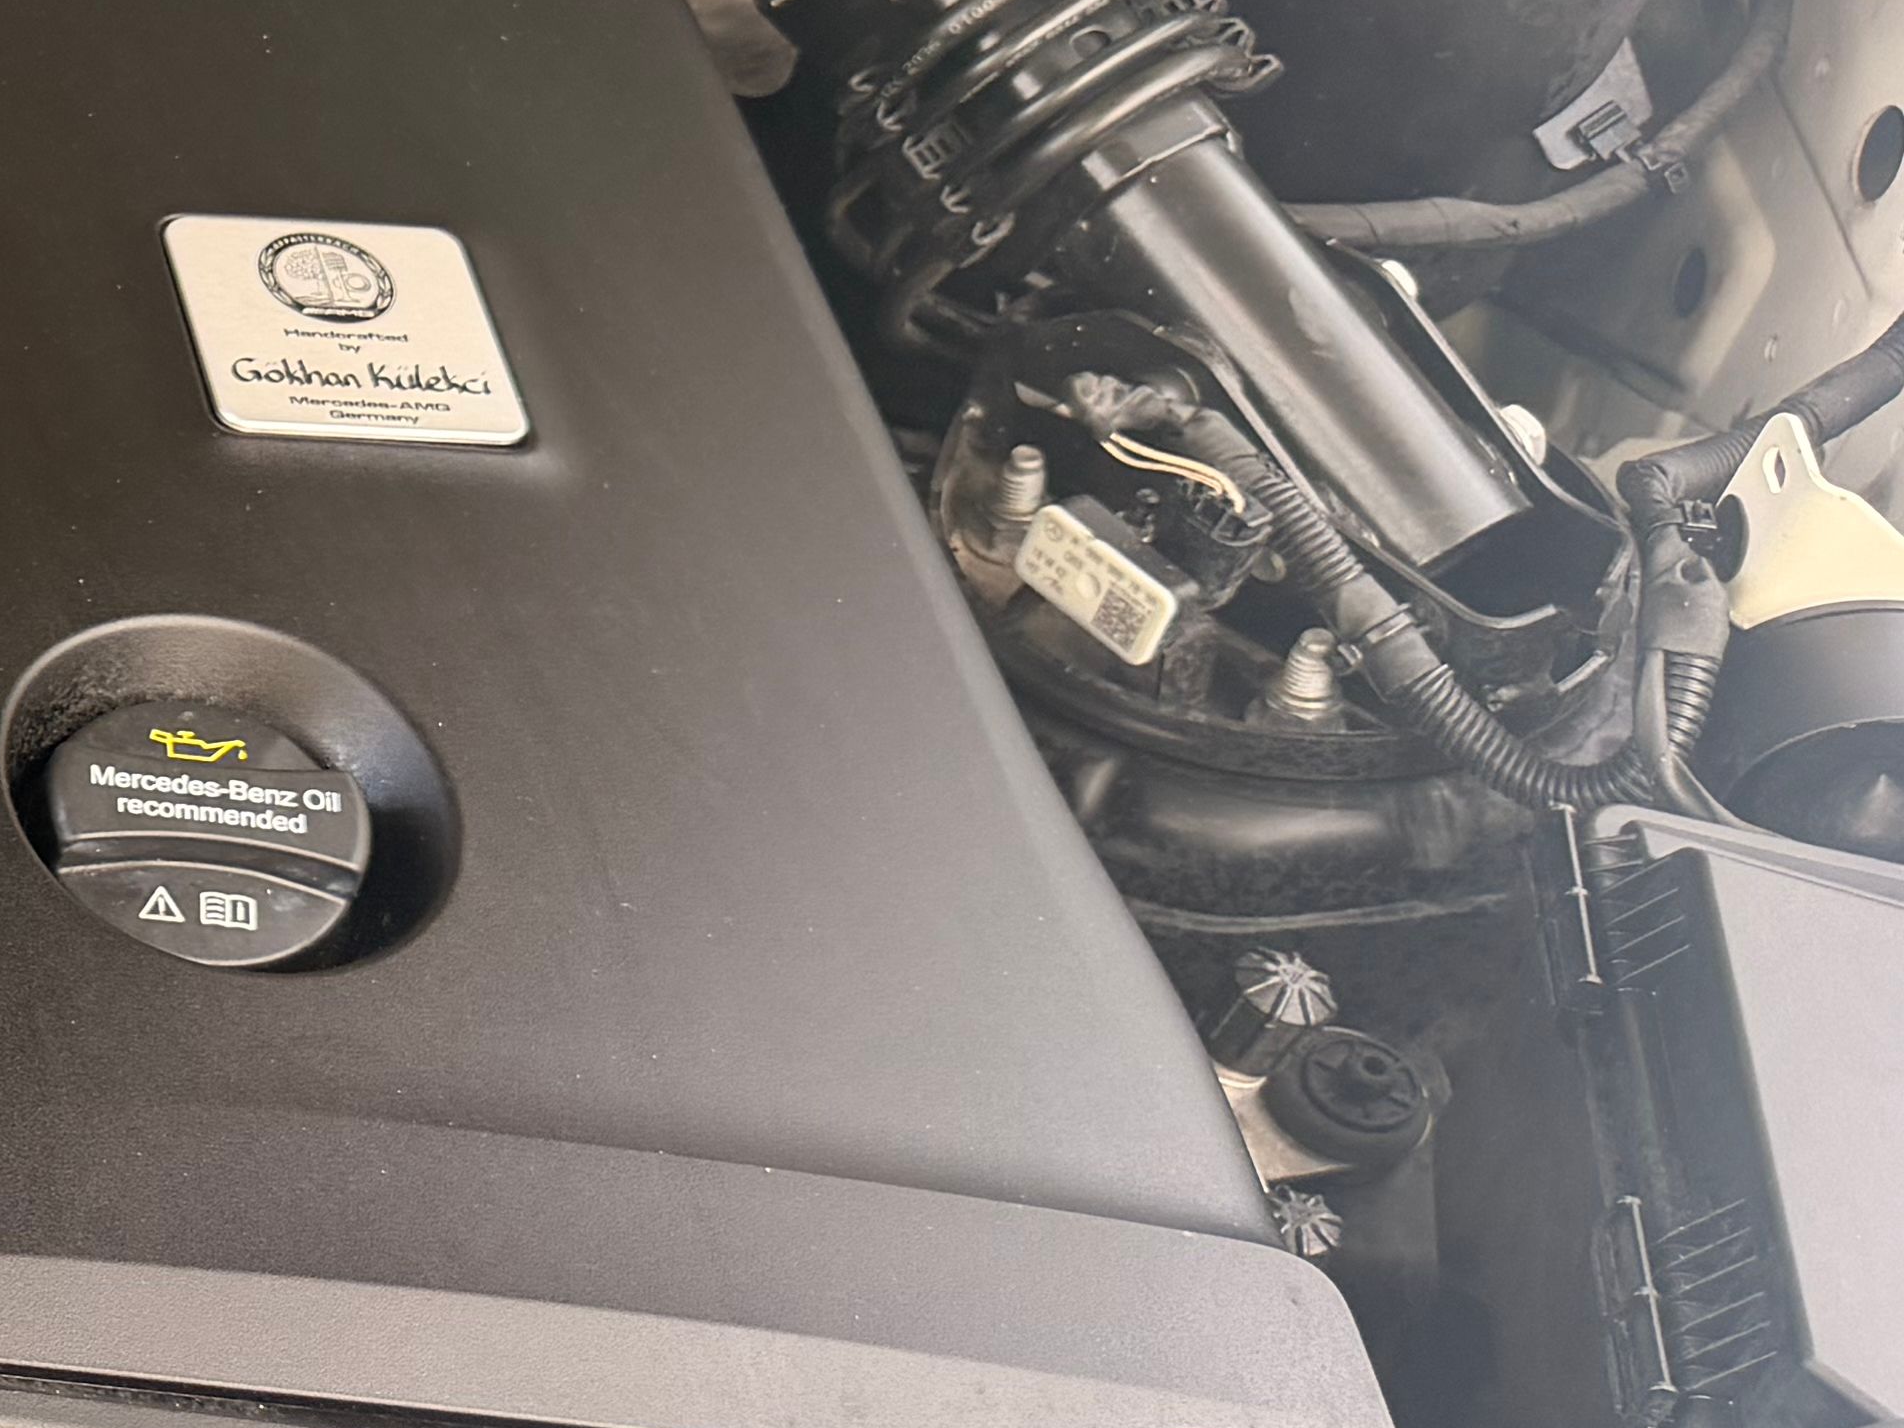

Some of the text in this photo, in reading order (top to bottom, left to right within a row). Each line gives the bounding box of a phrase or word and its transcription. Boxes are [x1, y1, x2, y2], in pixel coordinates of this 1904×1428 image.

[284, 328, 409, 343] Handcrafted
[339, 343, 361, 353] by
[289, 396, 451, 412] Mercedes-AMG
[329, 410, 419, 424] Germany
[90, 764, 342, 813] Mercedes-Benz Oil
[117, 796, 308, 834] recommended
